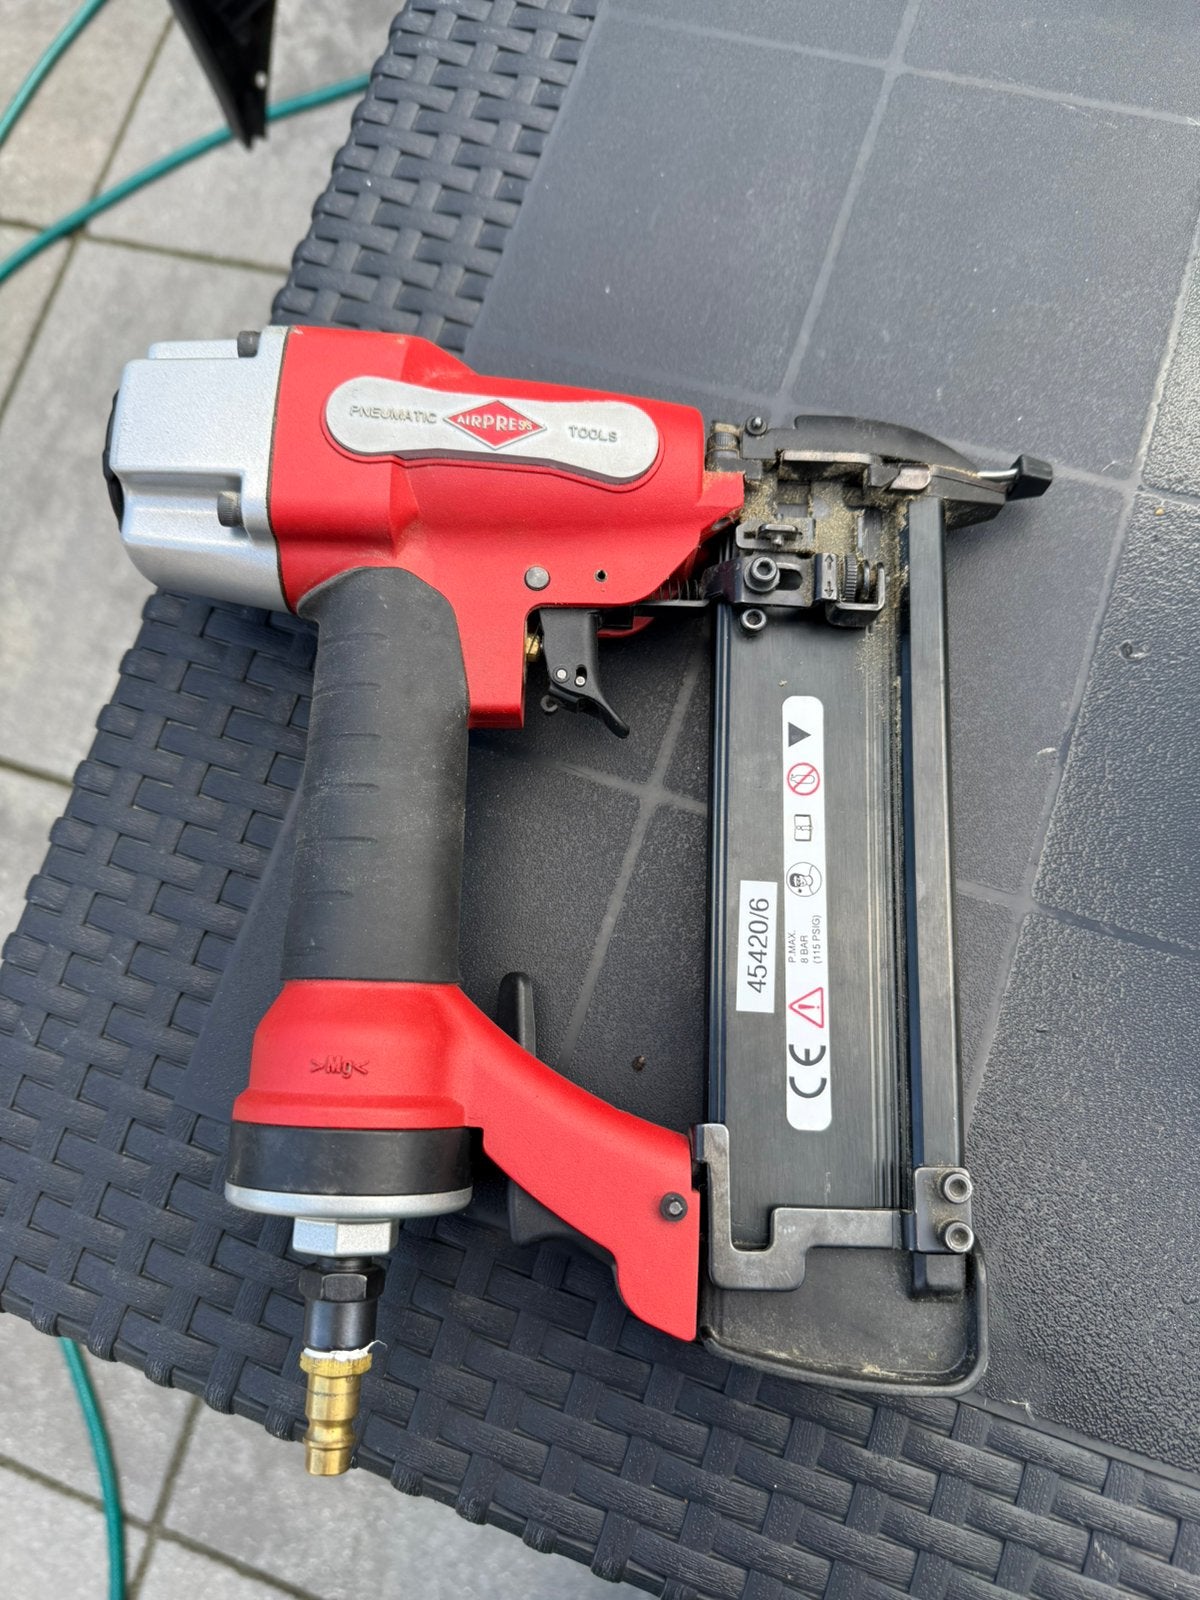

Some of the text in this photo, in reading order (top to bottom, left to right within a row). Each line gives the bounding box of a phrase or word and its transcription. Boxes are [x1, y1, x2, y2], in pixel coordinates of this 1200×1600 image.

[349, 405, 437, 424] PNEUMATIC
[456, 413, 533, 433] AIRPRESS
[568, 425, 617, 443] TOOLS
[747, 898, 770, 994] 45420/6
[800, 935, 809, 955] BAR
[812, 914, 823, 964] (115 PSIG)
